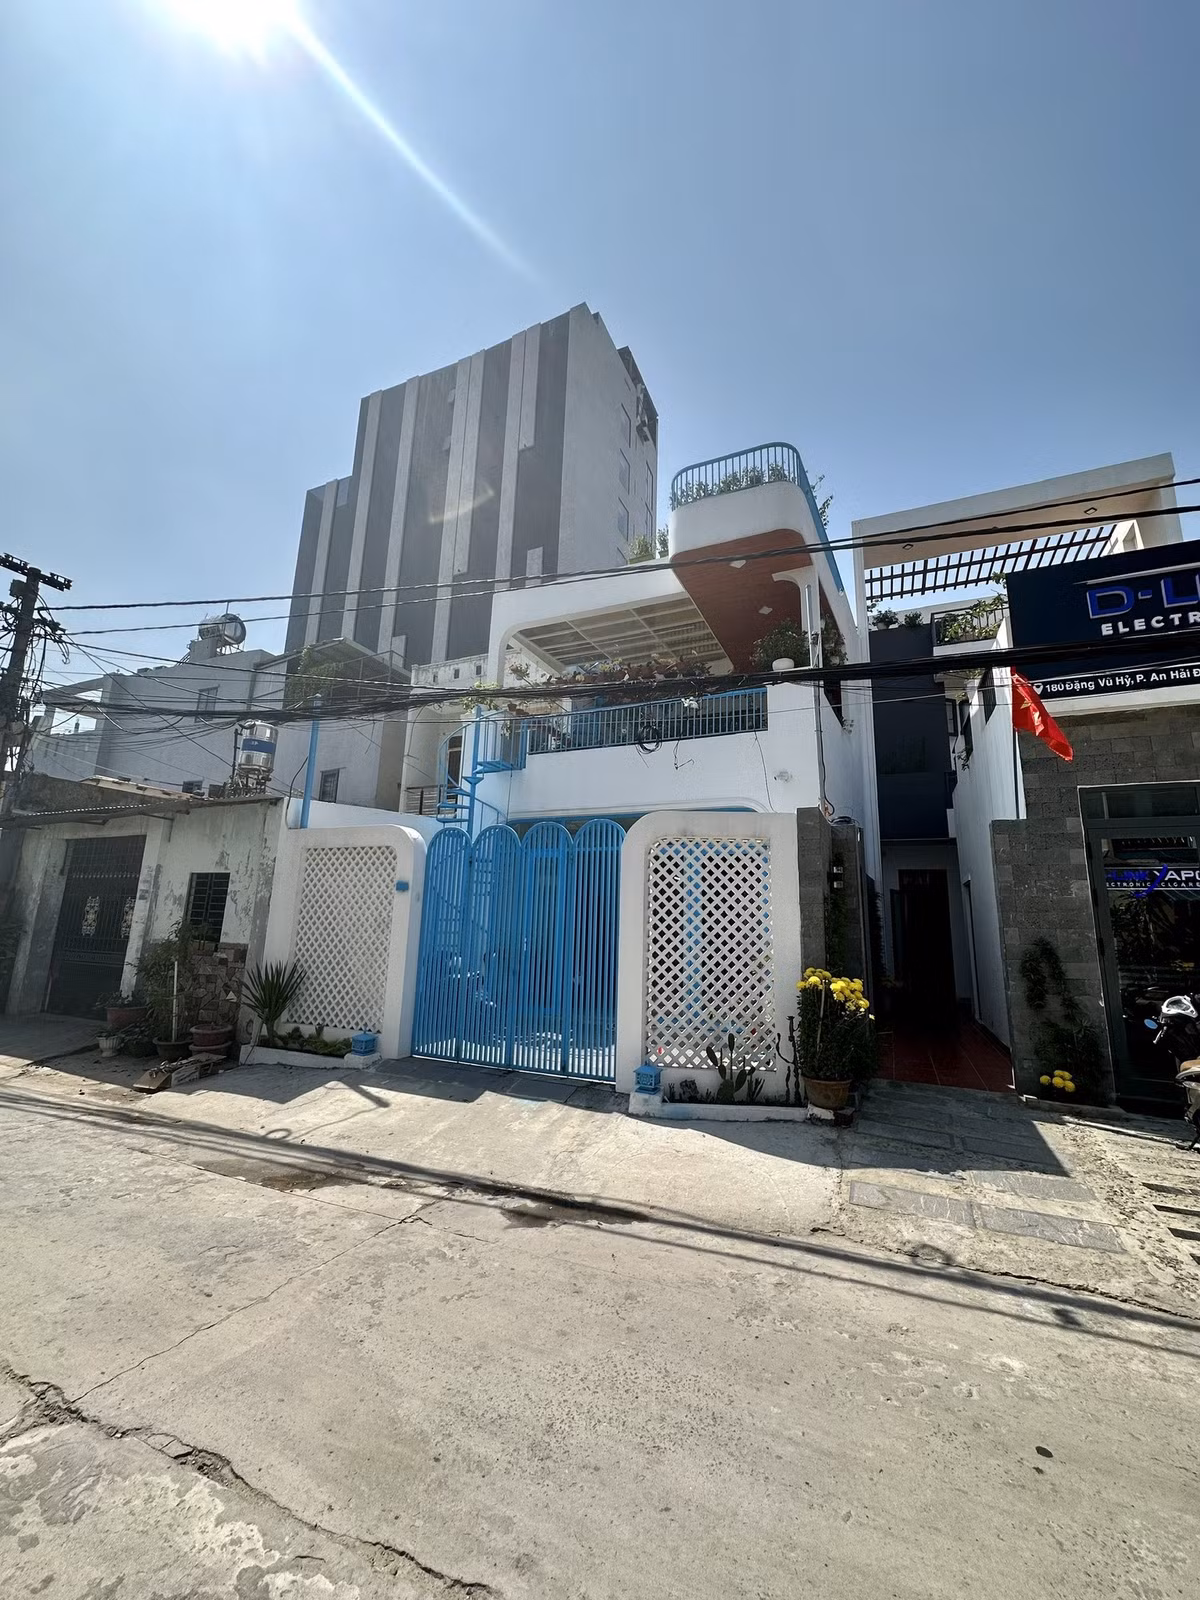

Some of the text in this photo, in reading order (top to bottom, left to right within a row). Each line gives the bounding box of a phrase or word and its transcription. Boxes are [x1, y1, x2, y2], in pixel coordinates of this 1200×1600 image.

[1101, 611, 1200, 636] ELECTR
[1065, 680, 1095, 692] Đặng
[1098, 677, 1113, 687] Vũ
[1136, 674, 1146, 683] P.
[1150, 672, 1167, 682] An
[1170, 668, 1190, 680] Hải
[1105, 870, 1150, 881] -LINK
